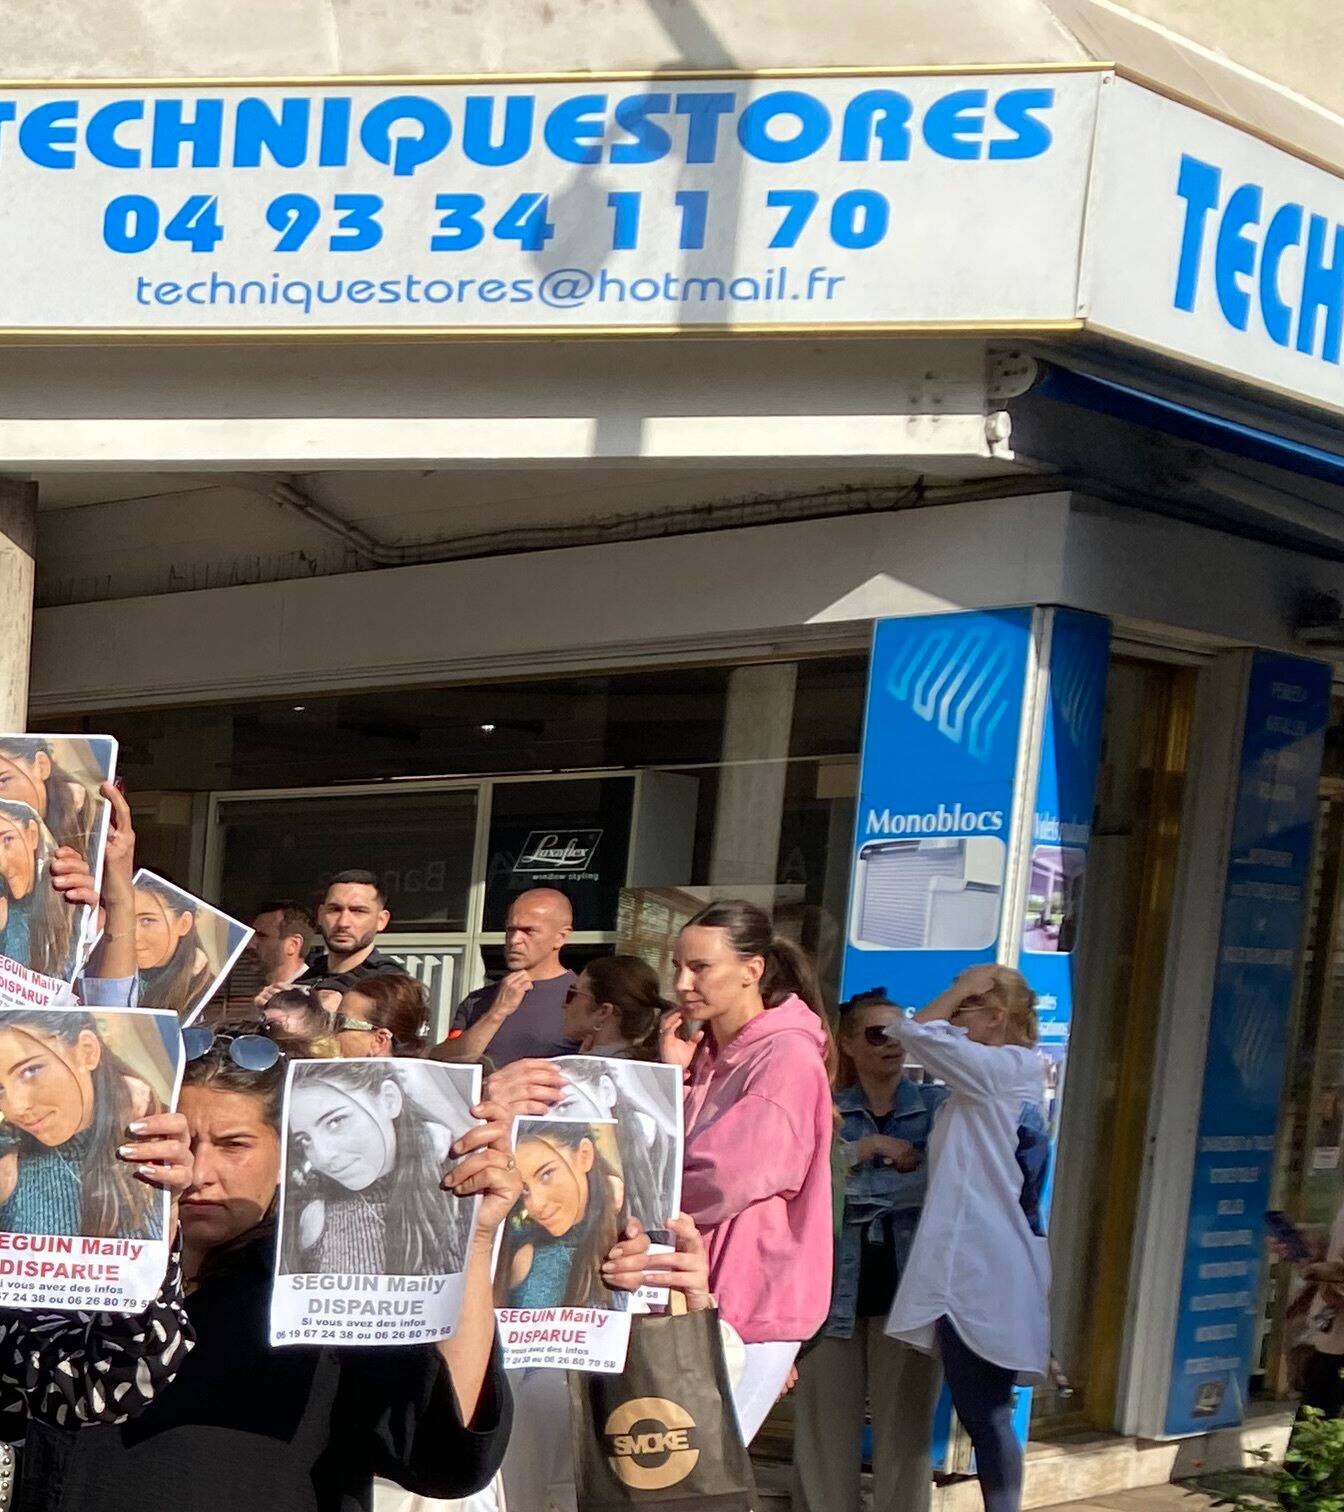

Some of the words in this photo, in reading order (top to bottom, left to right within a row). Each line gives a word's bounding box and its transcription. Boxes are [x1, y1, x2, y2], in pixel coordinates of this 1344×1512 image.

[102, 193, 224, 253] 04
[265, 193, 384, 252] 93
[430, 191, 555, 252] 34
[608, 190, 708, 250] 11
[766, 188, 891, 250] 70
[1174, 152, 1344, 366] TECH
[137, 265, 845, 313] techniquestores@hotmail.fr
[865, 803, 1003, 834] Monoblocs
[81, 1239, 144, 1261] Maily
[0, 1259, 120, 1281] DISPARUE
[7, 1281, 34, 1290] vous
[39, 1282, 66, 1291] avez
[69, 1283, 91, 1293] des
[95, 1283, 123, 1294] infos
[292, 1275, 378, 1291] SEGUIN
[387, 1277, 446, 1294] Maily
[12, 1293, 27, 1302] 24
[31, 1293, 45, 1303] 38
[49, 1295, 63, 1304] ou
[86, 1296, 101, 1306] 26
[103, 1297, 118, 1307] 80
[122, 1298, 137, 1307] 79
[308, 1299, 424, 1315] DISPARUE
[301, 1317, 313, 1326] Si
[316, 1319, 343, 1327] vous
[376, 1318, 397, 1327] des
[400, 1318, 426, 1327] infos
[500, 1310, 555, 1323] SEGUIN
[560, 1309, 609, 1327] Maily
[289, 1330, 301, 1338] 19
[303, 1330, 318, 1338] 67
[321, 1330, 335, 1338] 24
[340, 1331, 353, 1339] 38
[357, 1332, 371, 1340] ou
[374, 1330, 388, 1339] 06
[392, 1330, 405, 1339] 26
[508, 1329, 587, 1344] DISPARUE
[613, 1429, 689, 1456] SMOKE
